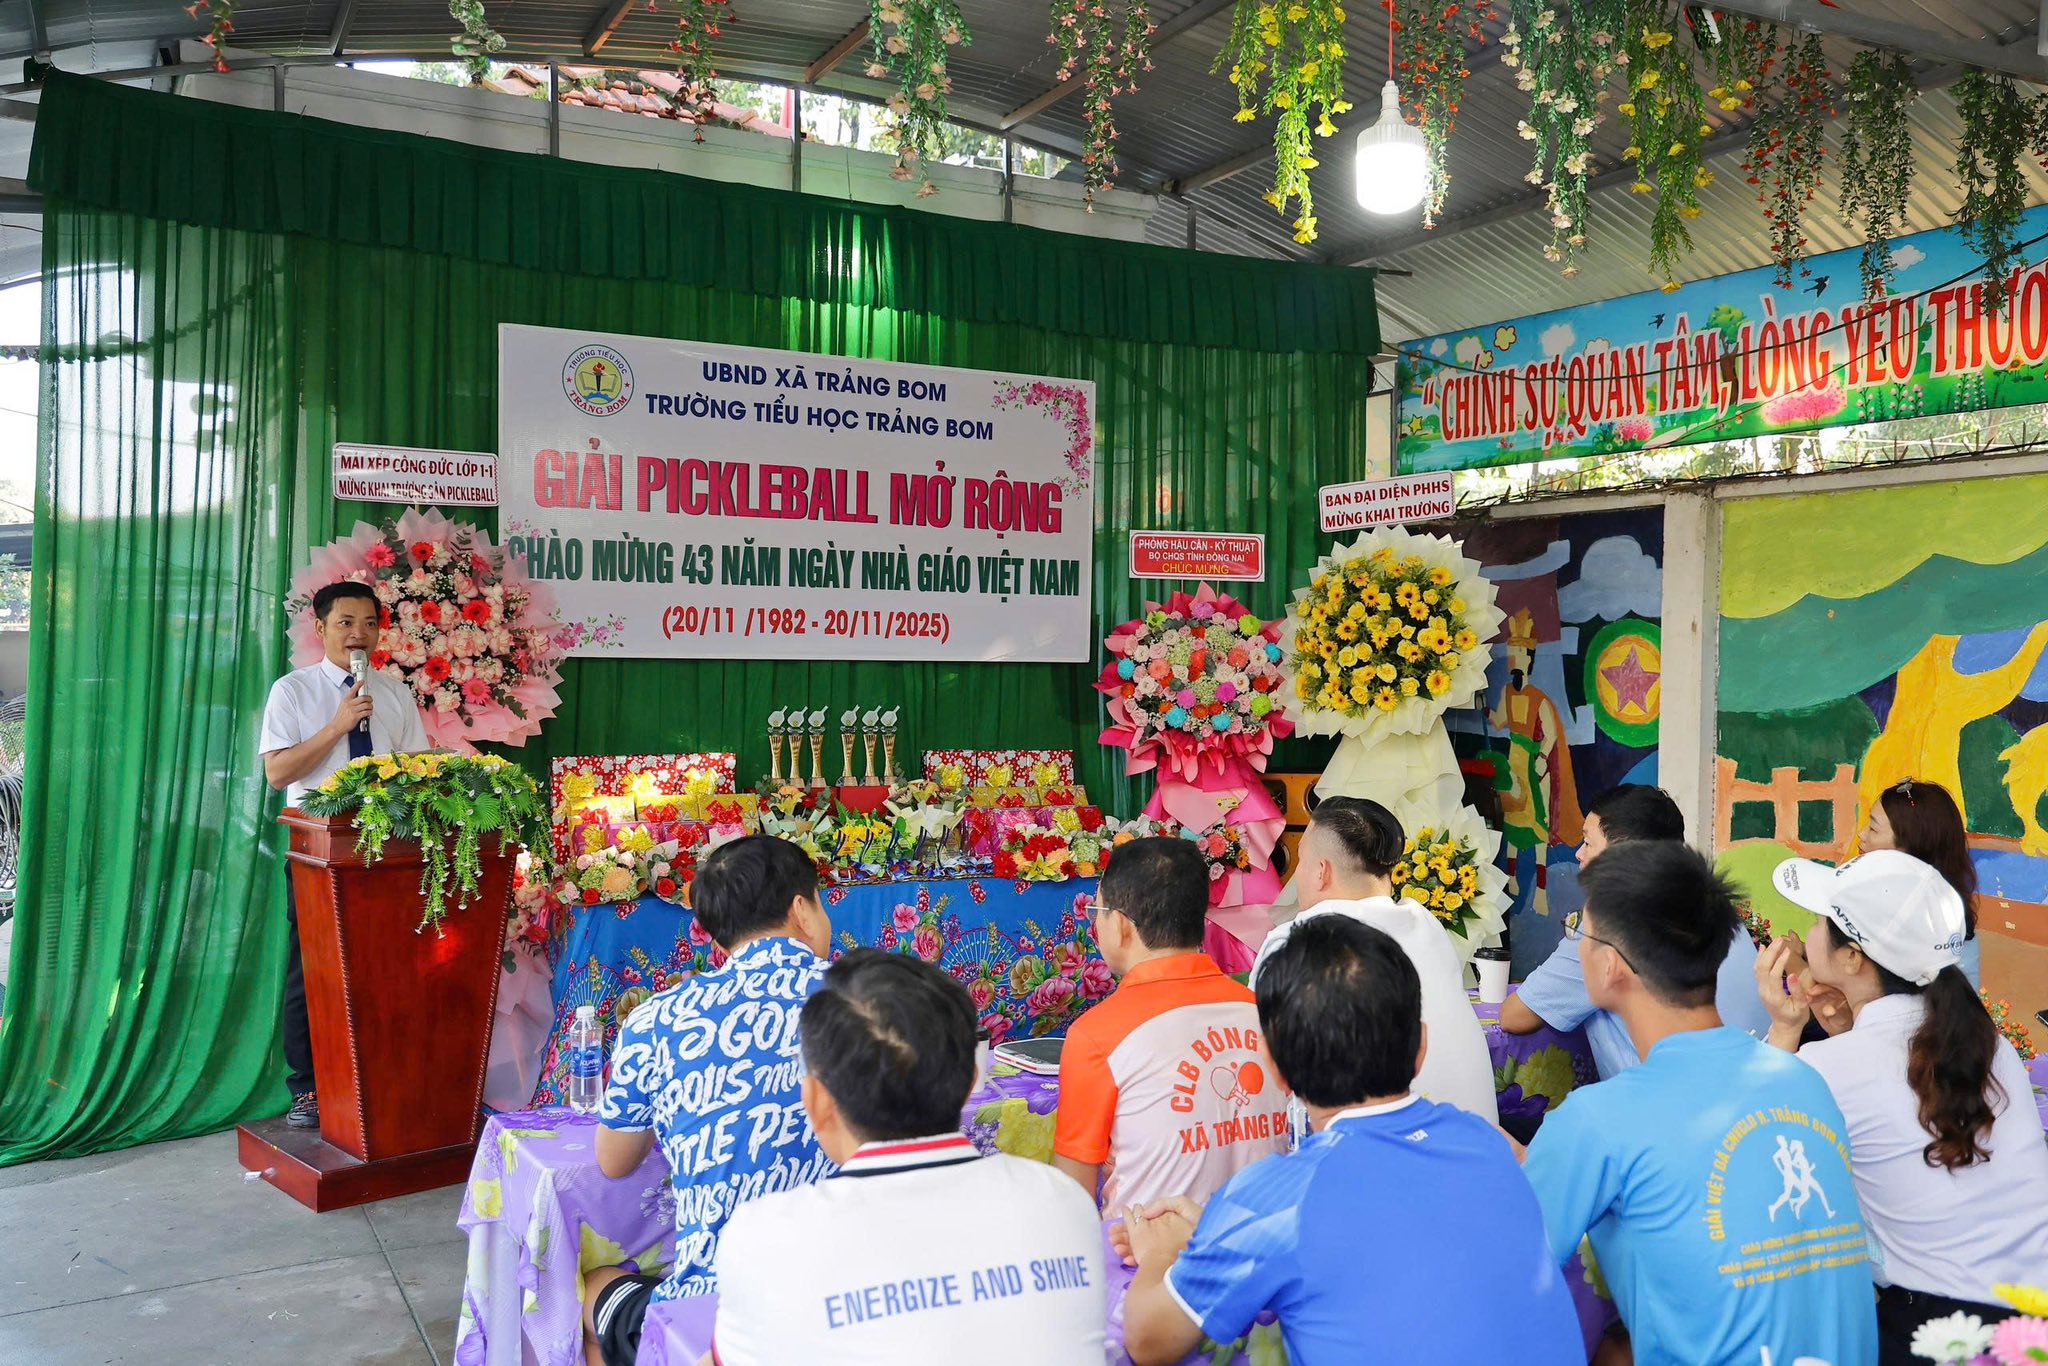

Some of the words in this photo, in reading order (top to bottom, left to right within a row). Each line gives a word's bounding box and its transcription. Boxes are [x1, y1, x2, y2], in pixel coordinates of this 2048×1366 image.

[703, 361, 767, 385] UBND
[775, 365, 808, 389] XÃ
[815, 367, 891, 397] TRẢNG
[898, 380, 947, 402] BOM
[1567, 345, 1645, 437] QUAN
[1740, 297, 1831, 400] LÒNG
[606, 395, 628, 413] BOM
[645, 391, 746, 421] TRƯỜNG
[753, 394, 799, 425] TIỂU
[807, 407, 859, 433] HỌC
[866, 408, 939, 437] TRẢNG
[946, 419, 994, 441] BOM
[393, 455, 426, 474] CÔNG
[429, 457, 454, 476] ĐỨC
[456, 459, 478, 477] LỚP
[480, 464, 493, 478] 1-1
[339, 476, 366, 496] MỪNG
[447, 486, 495, 502] PICKLEBALL
[533, 437, 623, 511] GIẢI
[637, 456, 878, 524] PICKLEBALL
[890, 460, 957, 529] MỞ
[963, 470, 1062, 539] RỘNG
[1325, 493, 1351, 507] BAN
[1354, 489, 1376, 505] ĐẠI
[1380, 483, 1410, 501] DIỆN
[1413, 480, 1450, 496] PHHS
[1325, 511, 1362, 528] MỪNG
[1366, 507, 1395, 523] KHAI
[592, 532, 674, 584] MỪNG
[681, 544, 713, 585] 43
[721, 537, 781, 587] NĂM
[788, 541, 855, 589] NGÀY
[861, 544, 911, 591] NHÀ
[917, 546, 971, 593] GIÁO
[977, 549, 1024, 602] VIỆT
[1029, 558, 1080, 596] NAM
[1162, 551, 1185, 561] CHQS
[1231, 553, 1245, 562] NAI
[1162, 561, 1193, 573] CHÚC
[824, 609, 950, 645] 20/11/2025)
[1831, 904, 1869, 943] APEX
[718, 1000, 802, 1059] GOL
[1170, 1060, 1200, 1113] CLB
[1192, 1026, 1258, 1063] BÓNG
[1179, 1121, 1210, 1154] XÃ
[825, 1274, 961, 1330] ENERGIZE
[972, 1265, 1023, 1302] AND
[1030, 1256, 1090, 1292] SHINE
